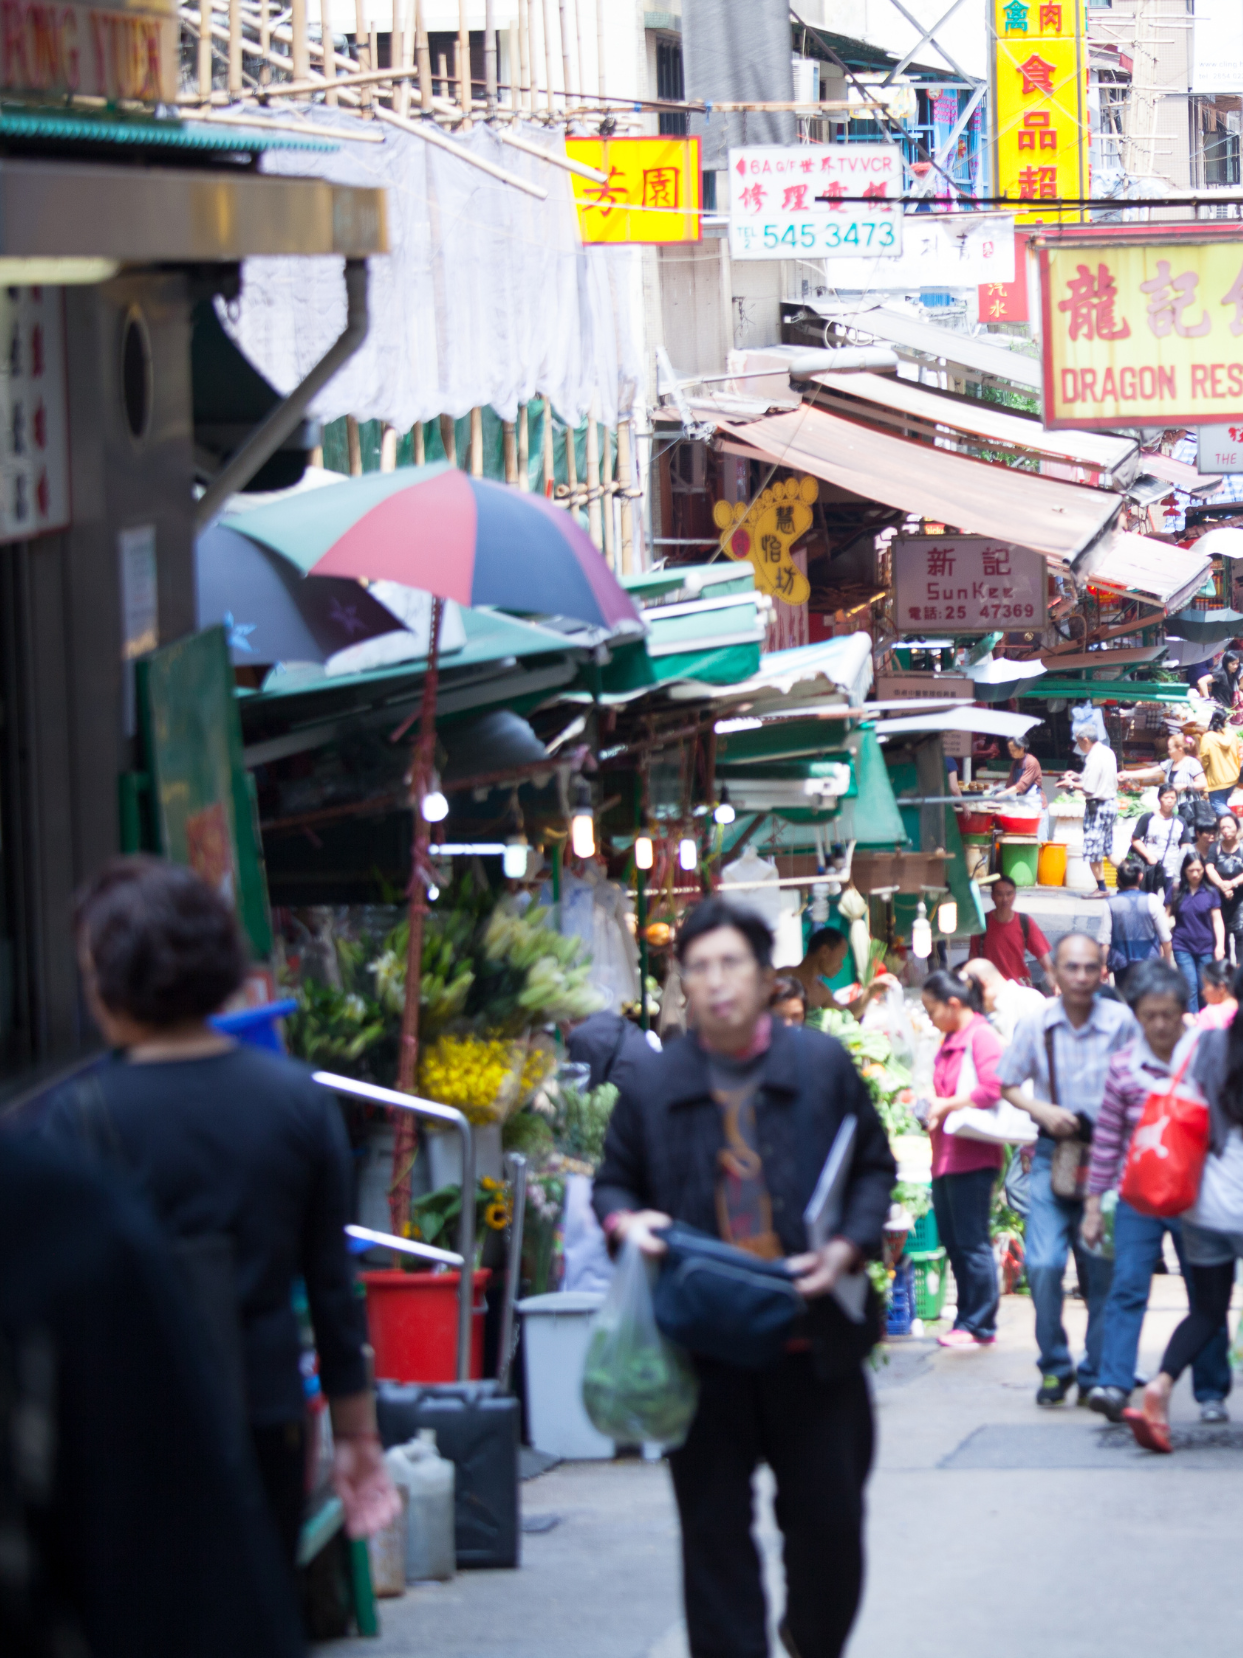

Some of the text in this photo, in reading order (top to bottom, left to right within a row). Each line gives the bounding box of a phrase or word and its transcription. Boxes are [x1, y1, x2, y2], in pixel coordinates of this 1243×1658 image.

[1016, 52, 1057, 224] 食品超
[763, 223, 816, 248] 545
[825, 221, 896, 247] 3473
[1061, 365, 1177, 404] DRAGON
[1215, 453, 1238, 466] THE
[926, 547, 1012, 577] 新記
